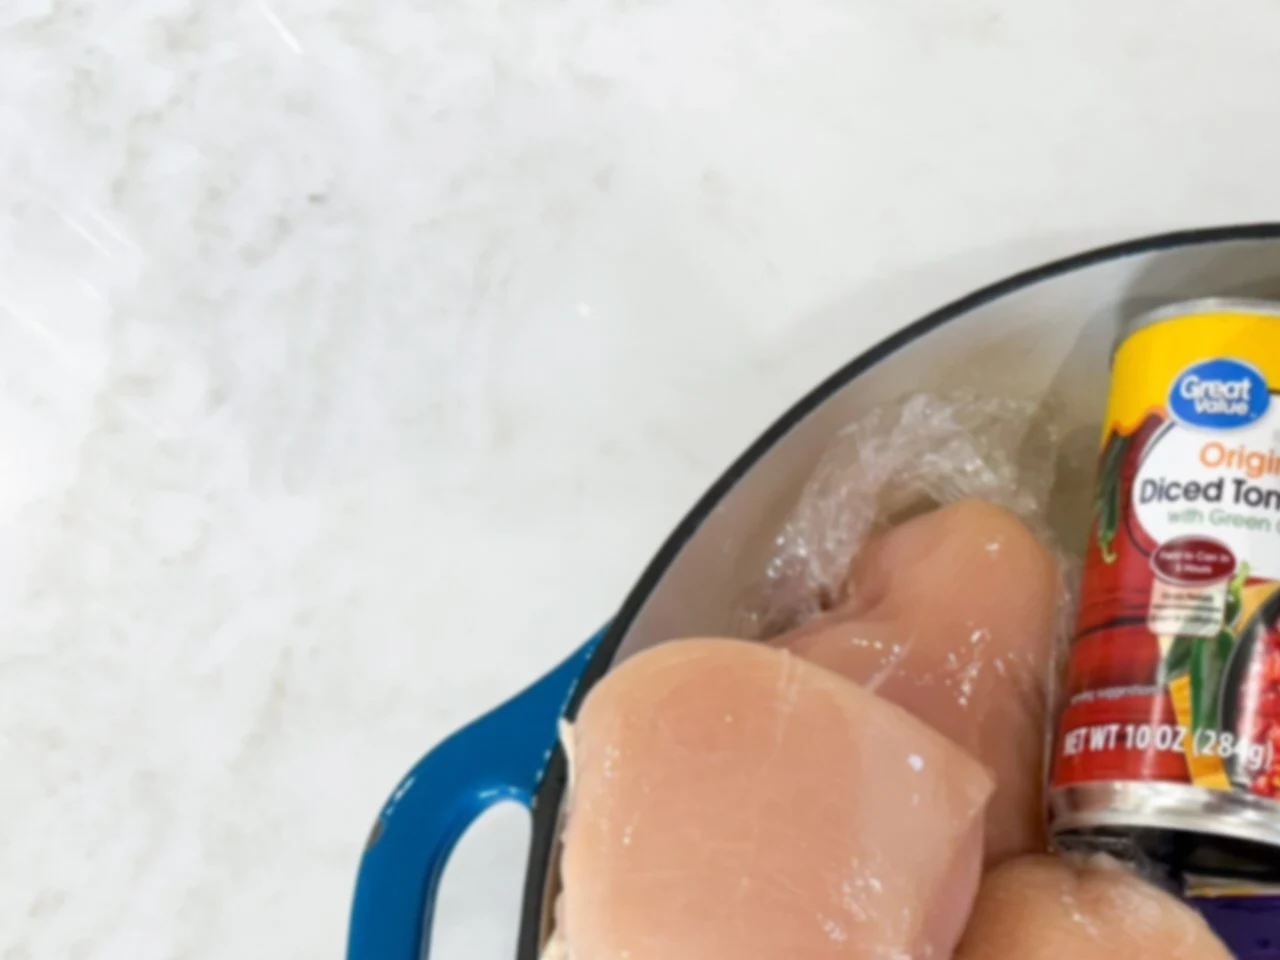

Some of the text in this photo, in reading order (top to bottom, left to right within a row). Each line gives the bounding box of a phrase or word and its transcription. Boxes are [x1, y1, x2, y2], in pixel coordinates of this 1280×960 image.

[1181, 375, 1251, 401] Great
[1195, 397, 1249, 416] Value
[1140, 477, 1225, 504] Diced
[1168, 507, 1204, 525] with
[1209, 509, 1269, 531] Green
[1063, 727, 1087, 756] NET
[1090, 723, 1120, 750] WT
[1125, 724, 1151, 750] 10
[1156, 725, 1186, 751] OZ
